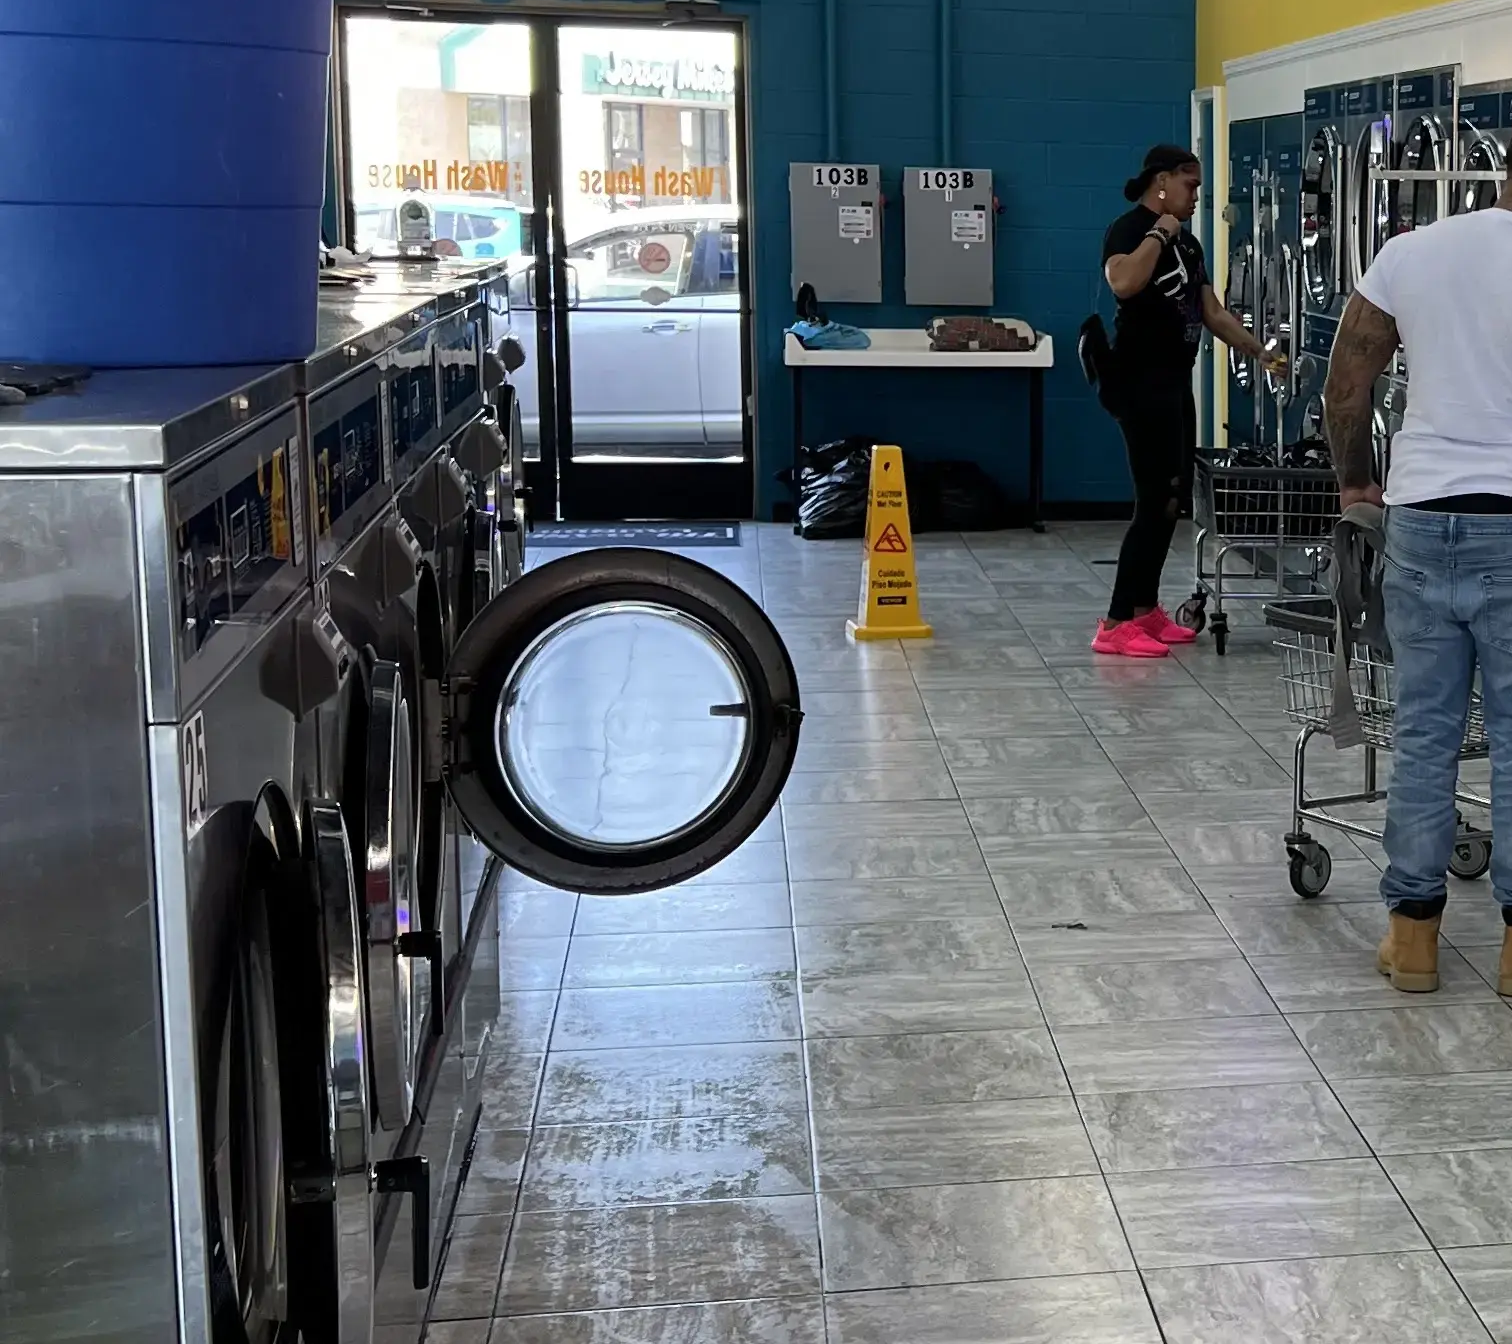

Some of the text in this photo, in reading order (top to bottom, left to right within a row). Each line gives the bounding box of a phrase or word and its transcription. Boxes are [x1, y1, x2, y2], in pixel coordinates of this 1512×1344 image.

[815, 167, 868, 186] 103B
[922, 171, 974, 189] 103B
[832, 187, 838, 197] 2
